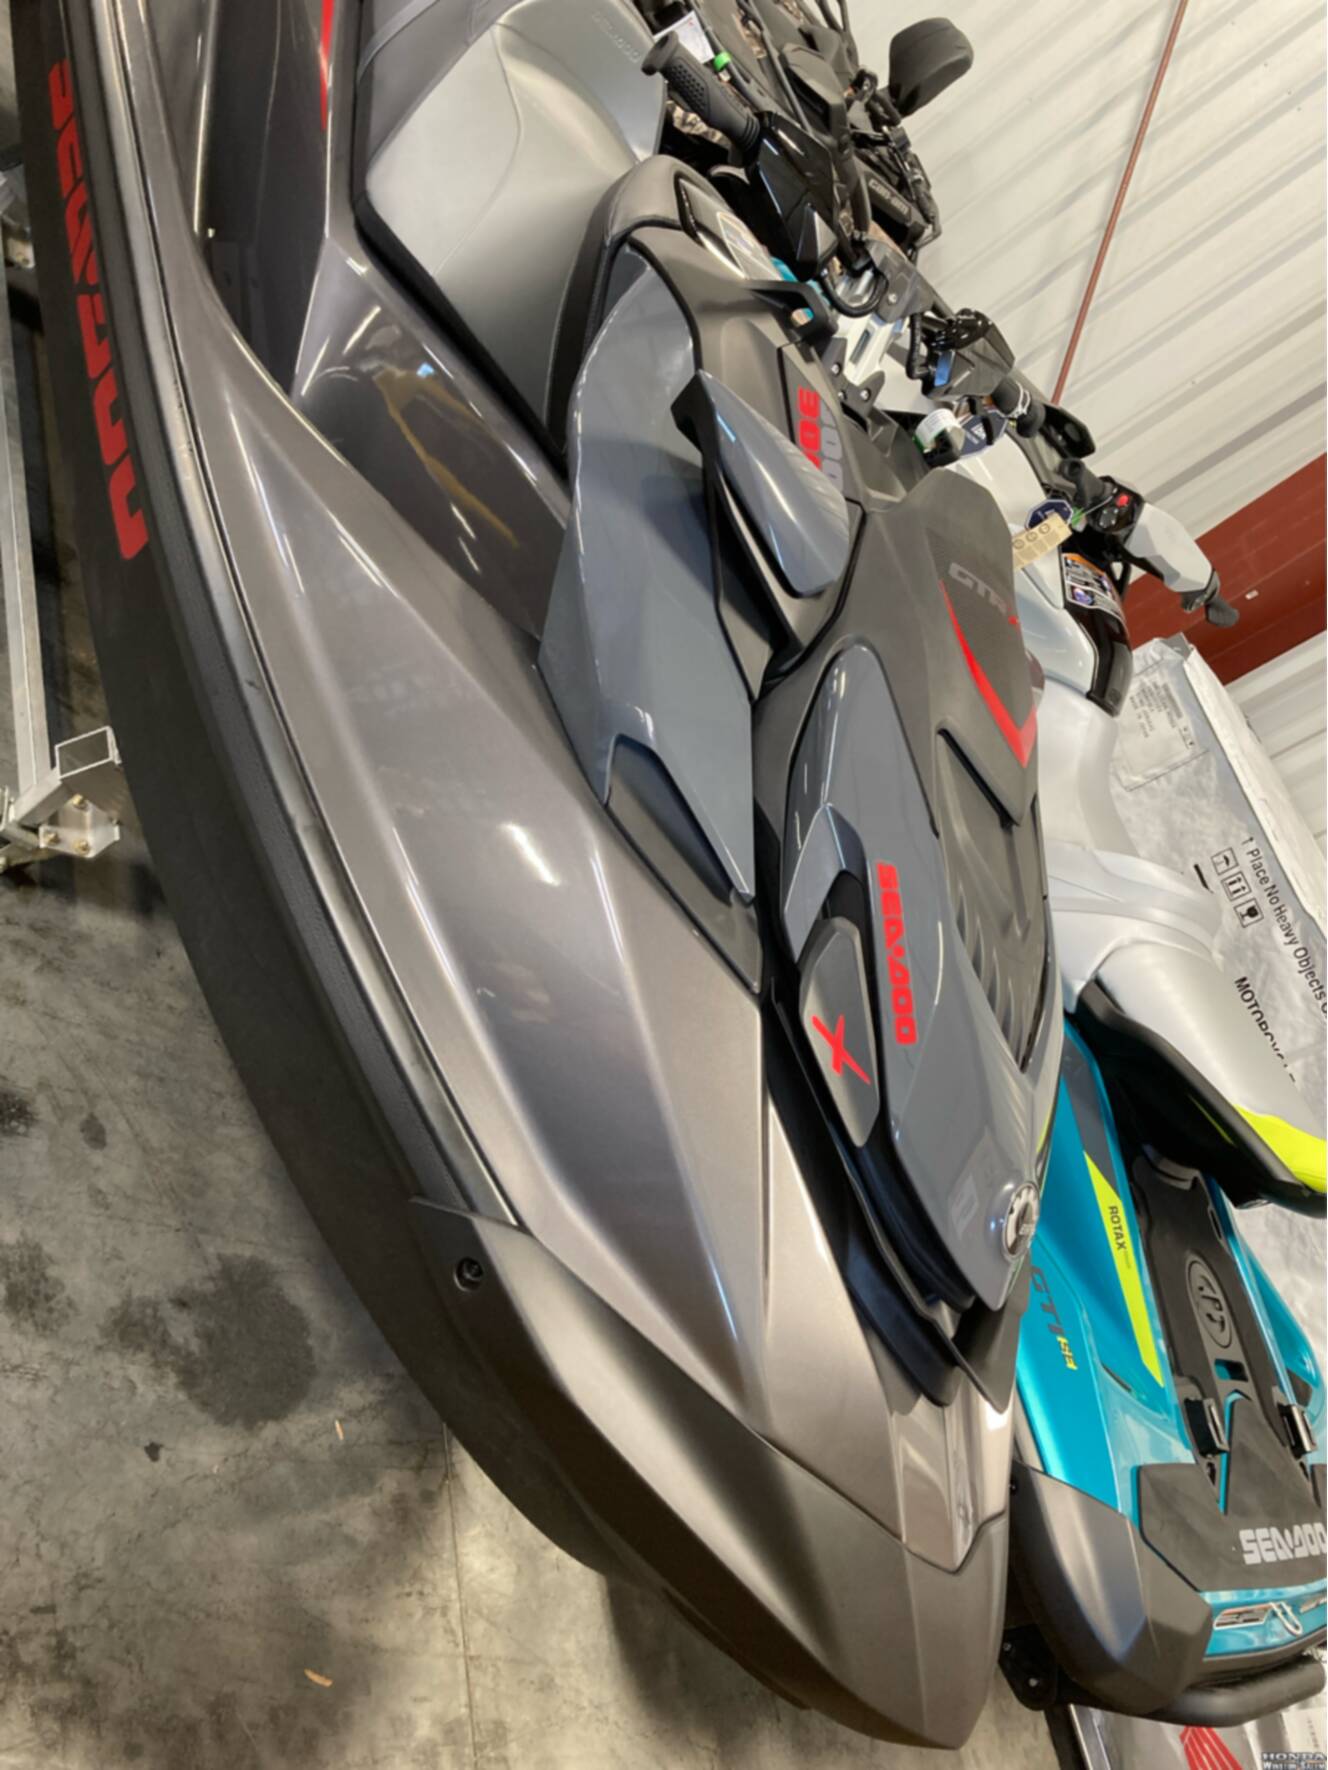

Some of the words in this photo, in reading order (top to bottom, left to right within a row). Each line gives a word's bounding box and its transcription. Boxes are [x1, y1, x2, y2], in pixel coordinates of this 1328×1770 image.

[1247, 848, 1270, 885] Place
[1264, 884, 1280, 905] No
[1273, 904, 1299, 945] Heavy
[1293, 946, 1327, 1000] Objects
[811, 1014, 871, 1085] X
[1108, 1205, 1127, 1251] ROTAX
